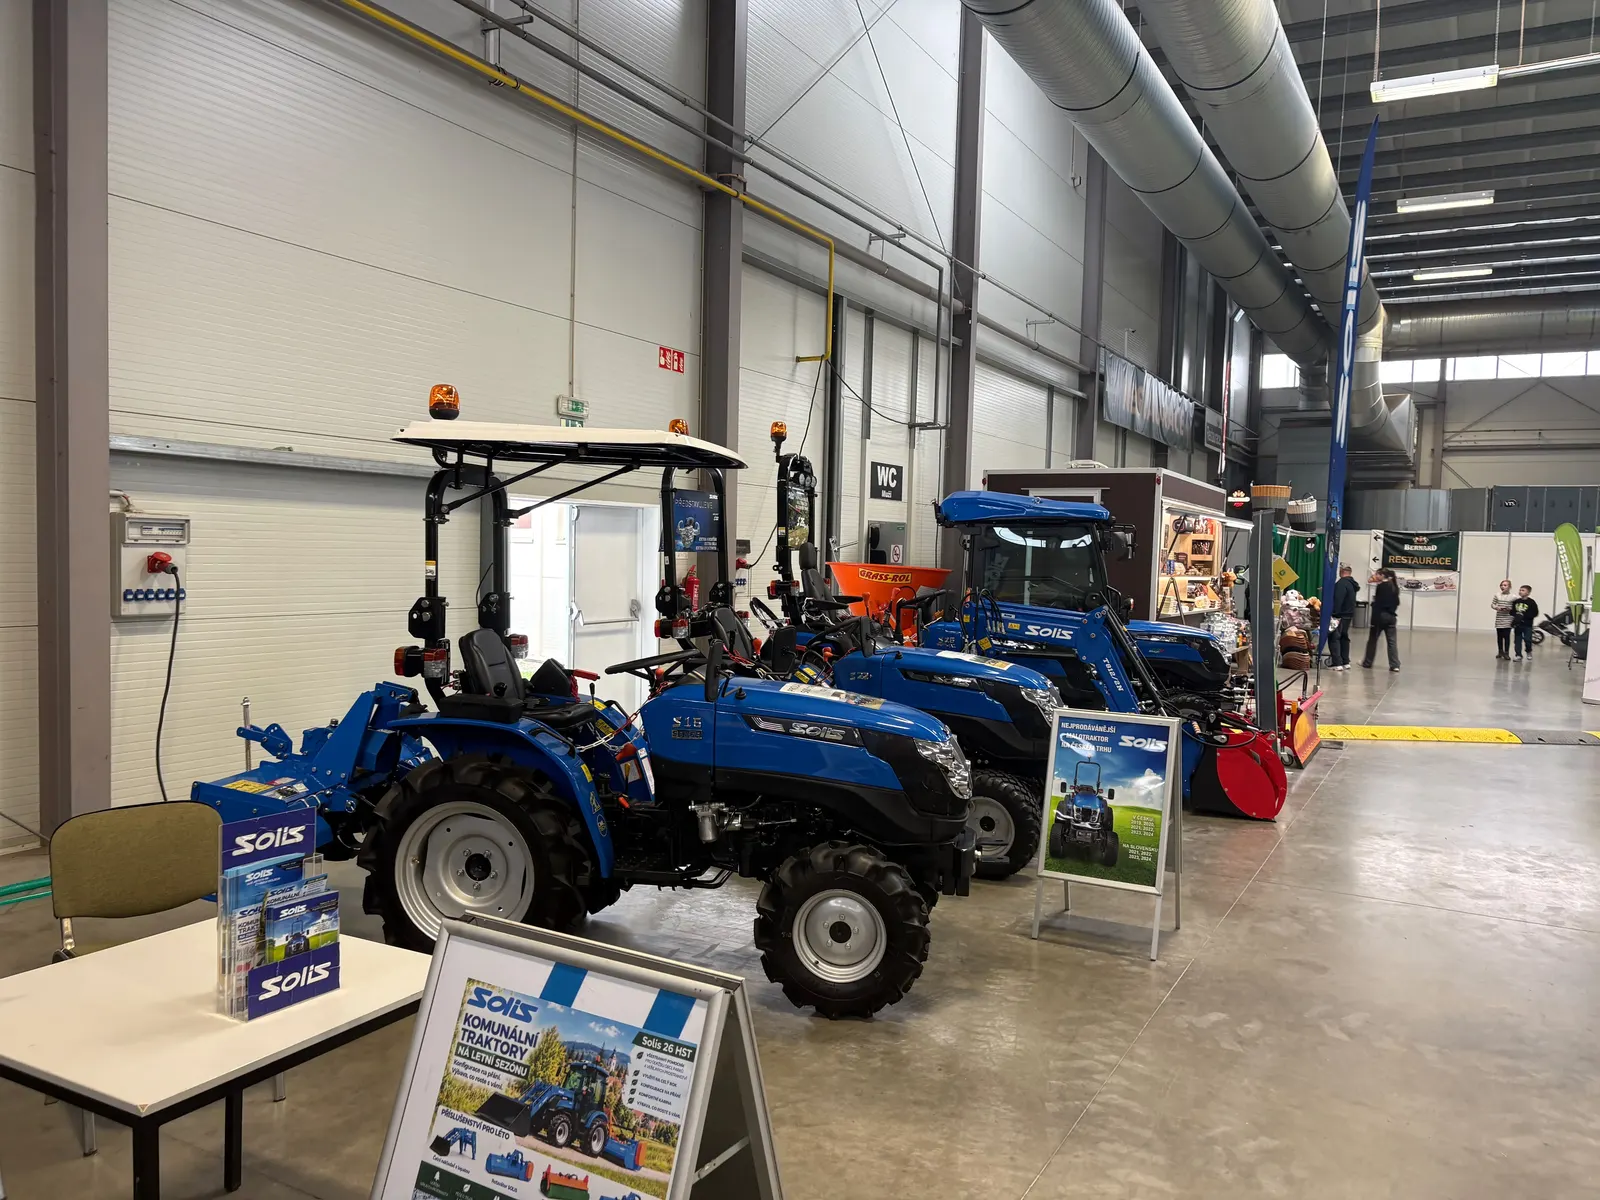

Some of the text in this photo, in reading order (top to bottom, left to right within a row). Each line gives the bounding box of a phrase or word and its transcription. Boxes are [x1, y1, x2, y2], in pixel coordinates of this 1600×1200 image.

[877, 465, 897, 488] WC
[1388, 555, 1452, 565] RESTAURACE
[859, 568, 911, 582] GRASS-ROL
[463, 1012, 540, 1048] KOMUNÁLNÍ
[461, 1028, 528, 1060] TRAKTORY
[641, 1036, 693, 1059] Solis 26 HST
[453, 1060, 481, 1073] Konfigurace
[471, 1050, 495, 1066] LETNÍ
[494, 1058, 528, 1077] SEZÓNU
[440, 1108, 510, 1140] PŘÍSLUŠENSTVÍ PRO LÉTO
